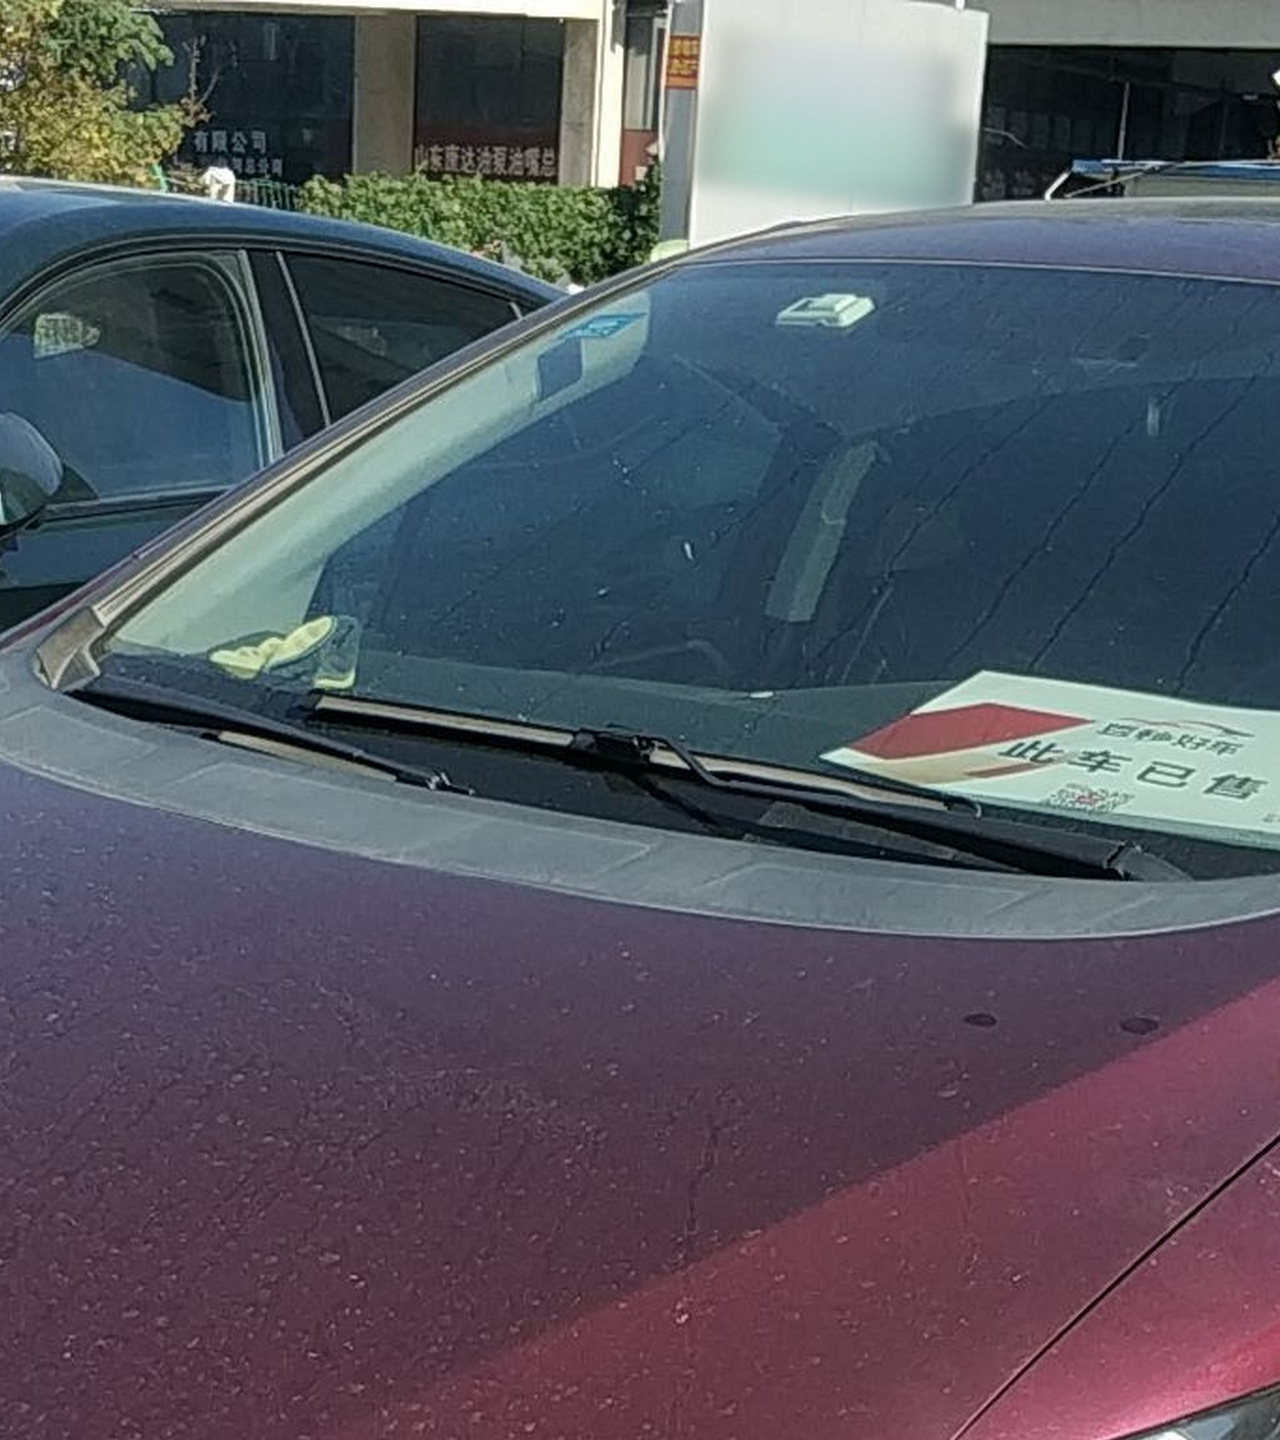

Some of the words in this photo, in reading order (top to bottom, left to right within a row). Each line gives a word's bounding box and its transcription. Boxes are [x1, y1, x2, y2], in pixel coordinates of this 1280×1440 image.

[193, 129, 267, 153] 有限公司
[997, 739, 1269, 800] 此车已售
